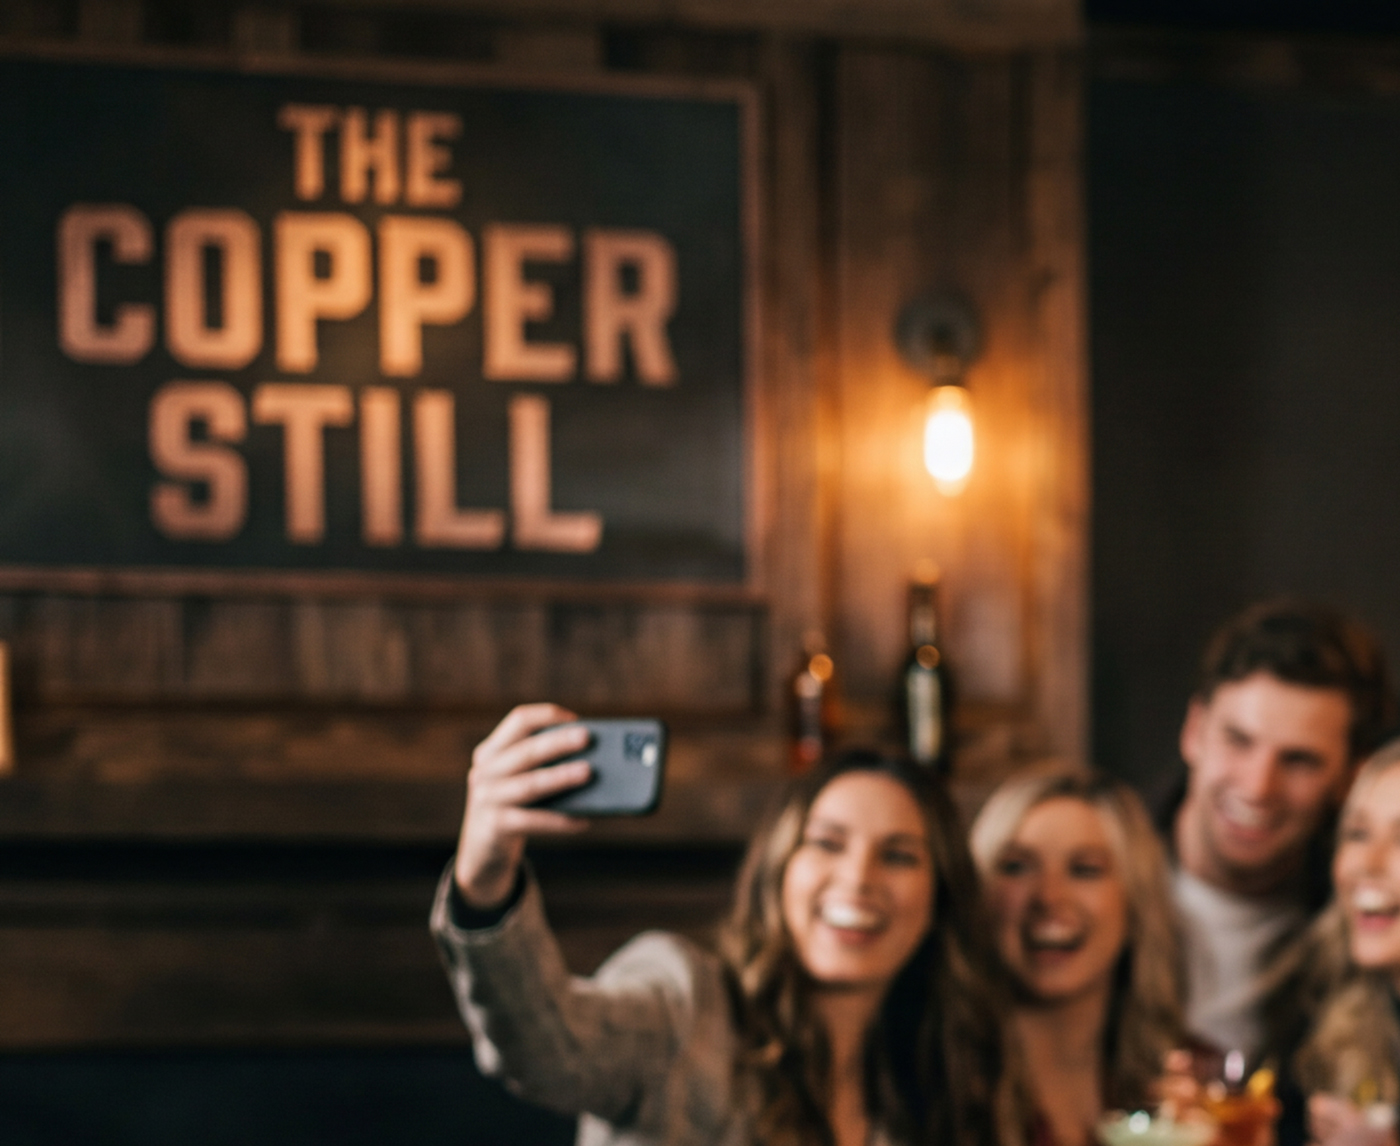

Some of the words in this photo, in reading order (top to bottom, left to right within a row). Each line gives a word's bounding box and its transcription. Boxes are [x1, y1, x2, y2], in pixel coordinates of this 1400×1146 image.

[280, 106, 462, 206] THE
[59, 206, 677, 385] COPPER
[150, 381, 602, 553] STILL
